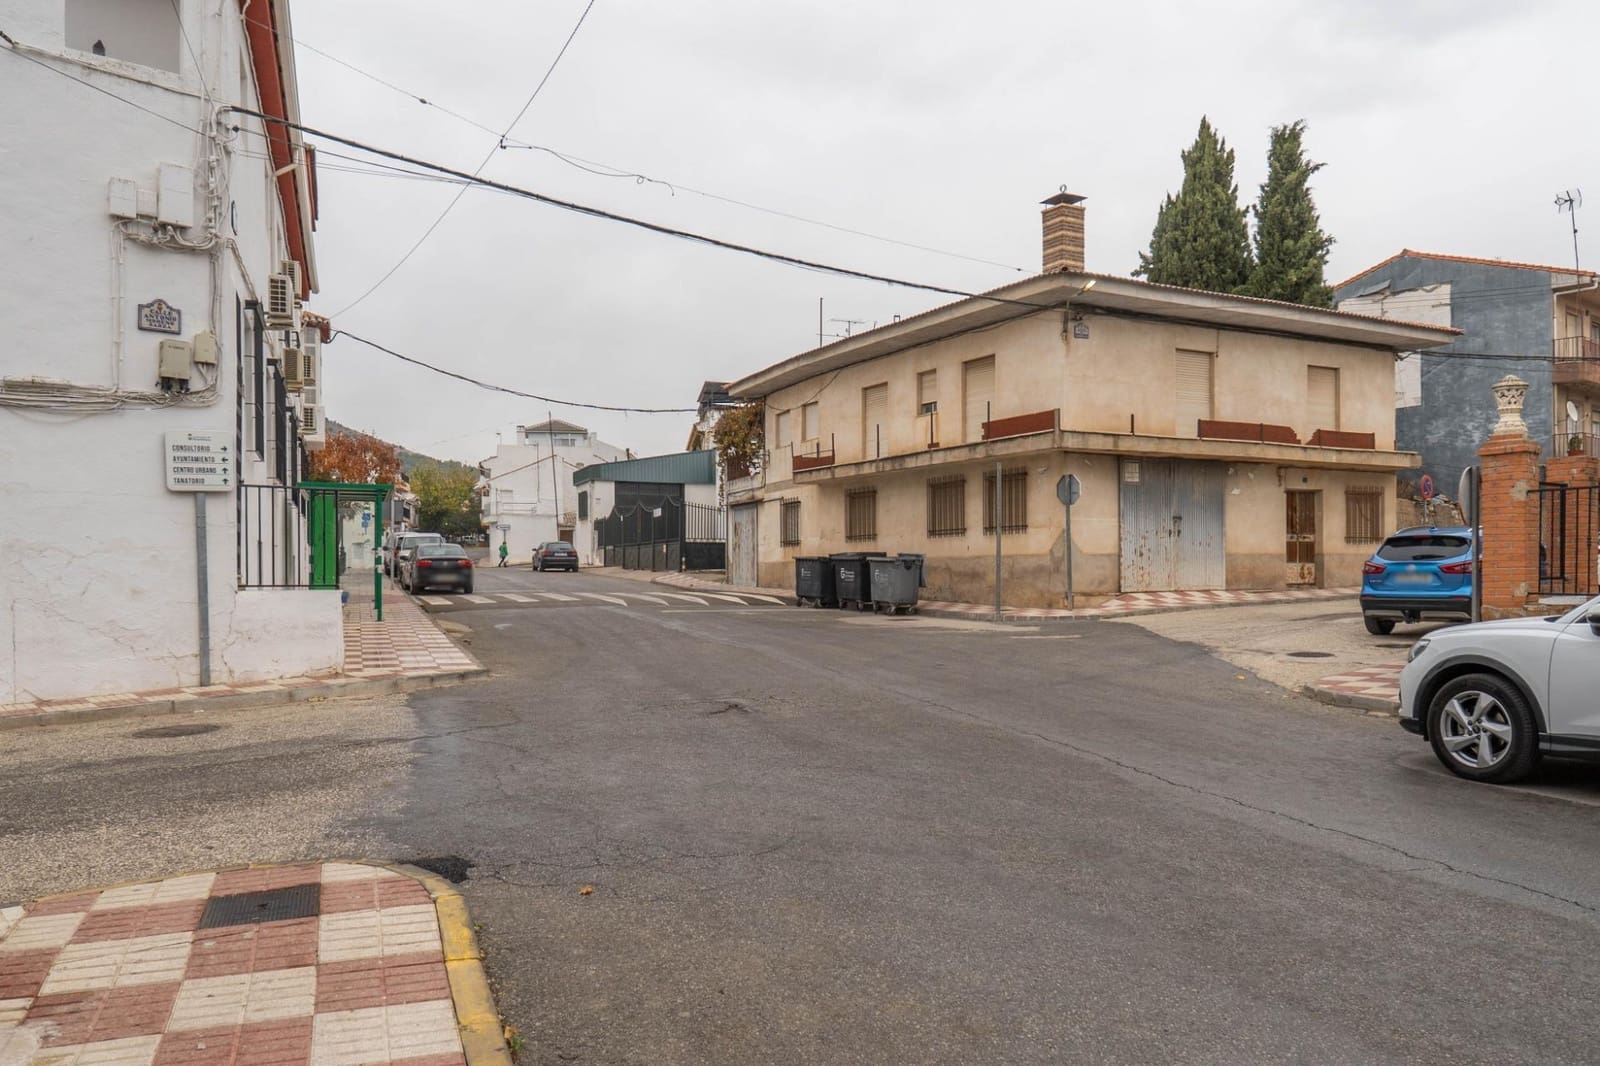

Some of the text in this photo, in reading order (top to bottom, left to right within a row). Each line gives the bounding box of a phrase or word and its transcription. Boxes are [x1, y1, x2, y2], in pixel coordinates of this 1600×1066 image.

[144, 313, 177, 322] ANTONIO
[172, 444, 211, 452] CONSULTORIO
[172, 455, 216, 463] AYUNTAMIENTO
